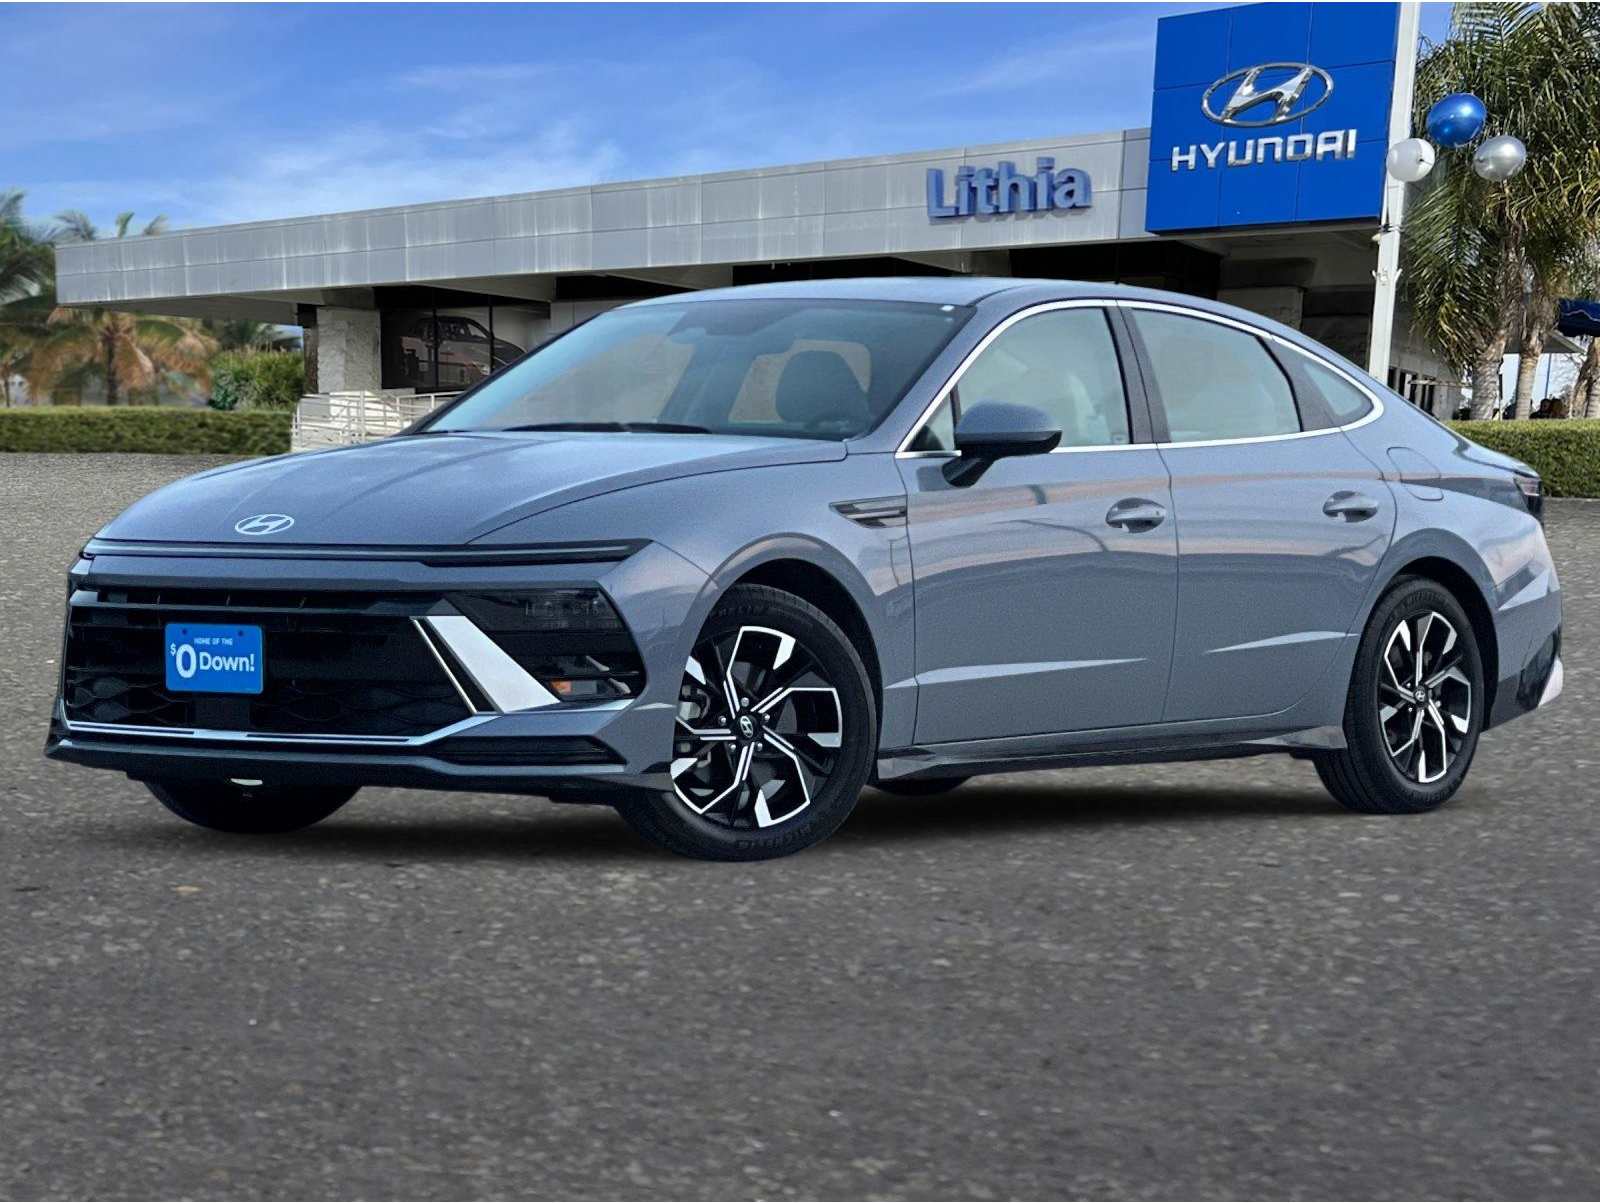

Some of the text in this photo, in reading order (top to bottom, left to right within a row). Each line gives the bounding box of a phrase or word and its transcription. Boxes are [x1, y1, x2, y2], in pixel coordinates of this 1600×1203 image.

[1171, 129, 1357, 171] HYUNDAI
[927, 156, 1093, 219] Lithia
[199, 651, 255, 672] Down!
